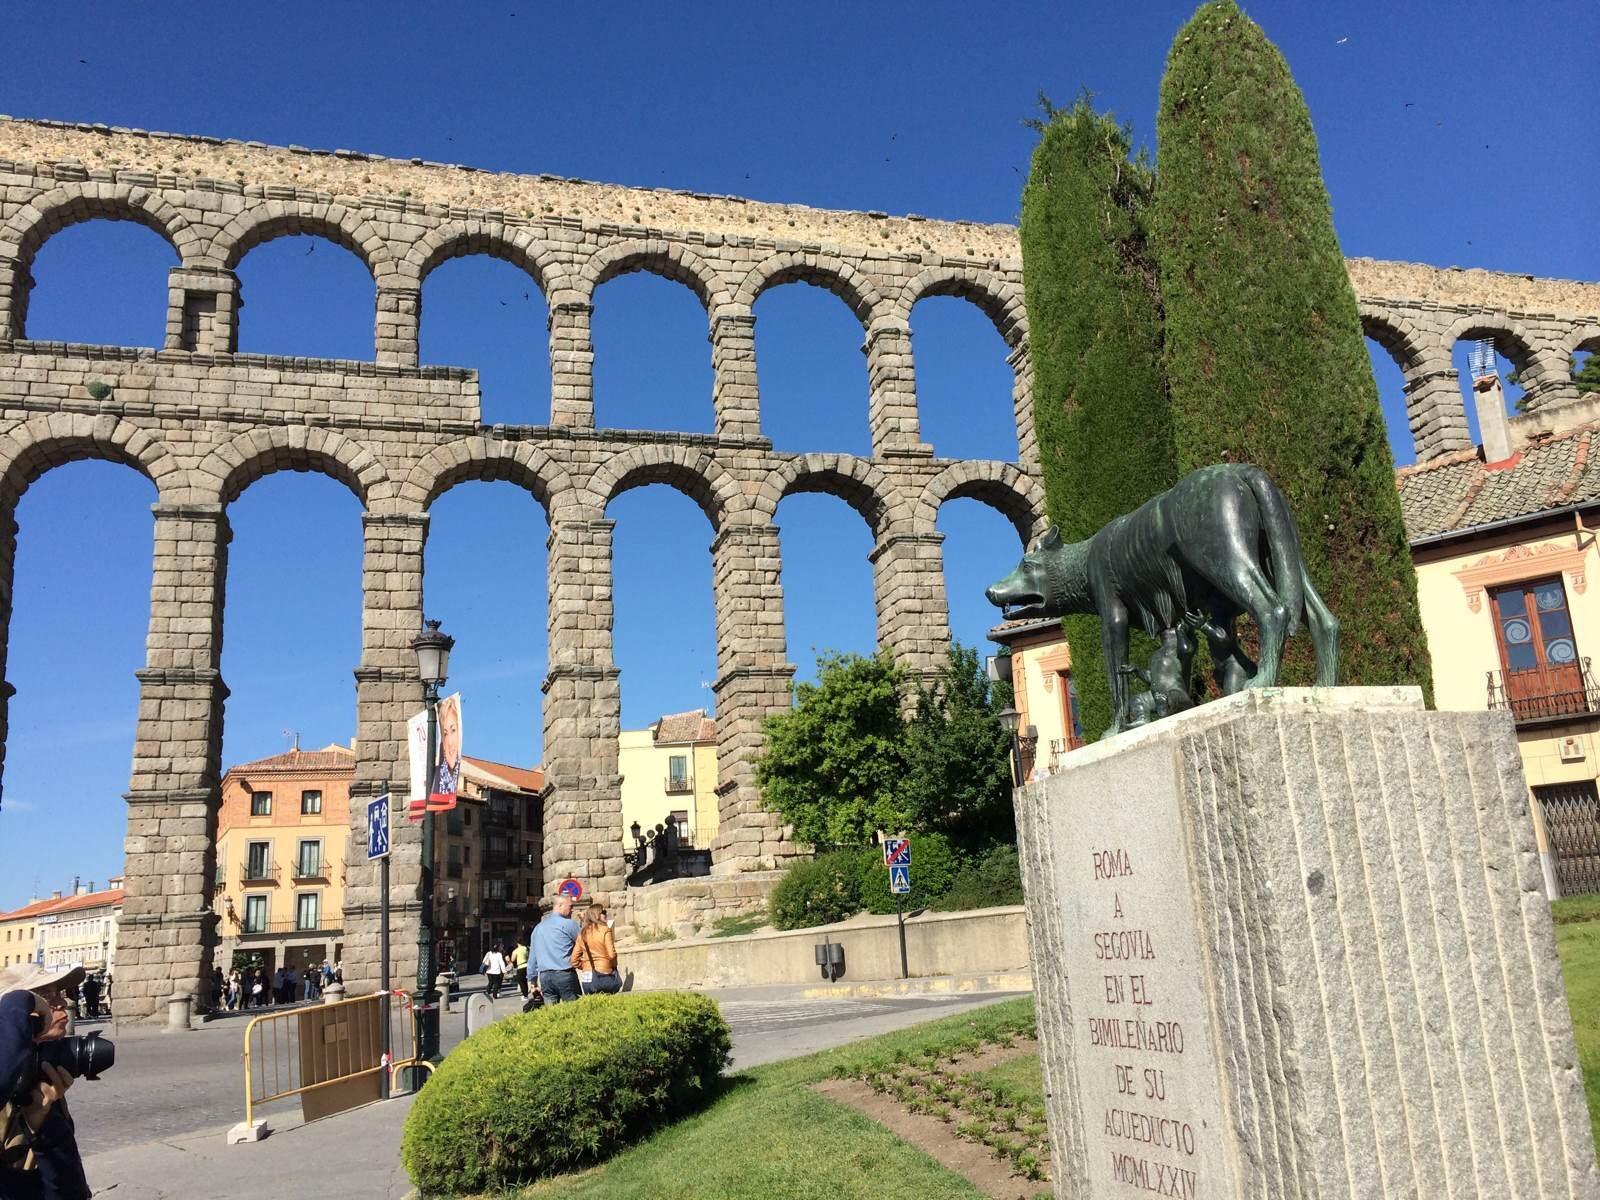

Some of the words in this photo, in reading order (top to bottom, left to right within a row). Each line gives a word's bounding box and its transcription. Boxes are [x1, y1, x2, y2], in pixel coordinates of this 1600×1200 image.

[1092, 848, 1133, 880] ROMA
[1113, 891, 1124, 918] A
[1094, 930, 1156, 961] SEGOVIA
[1104, 975, 1124, 1004] EN
[1129, 975, 1153, 1006] EL
[1089, 1017, 1184, 1054] BIMILENARIO
[1115, 1064, 1136, 1096] DE
[1143, 1068, 1165, 1101] SU
[1104, 1108, 1194, 1155] ACUEDUCTO
[1111, 1151, 1196, 1200] MCMLXXIV
